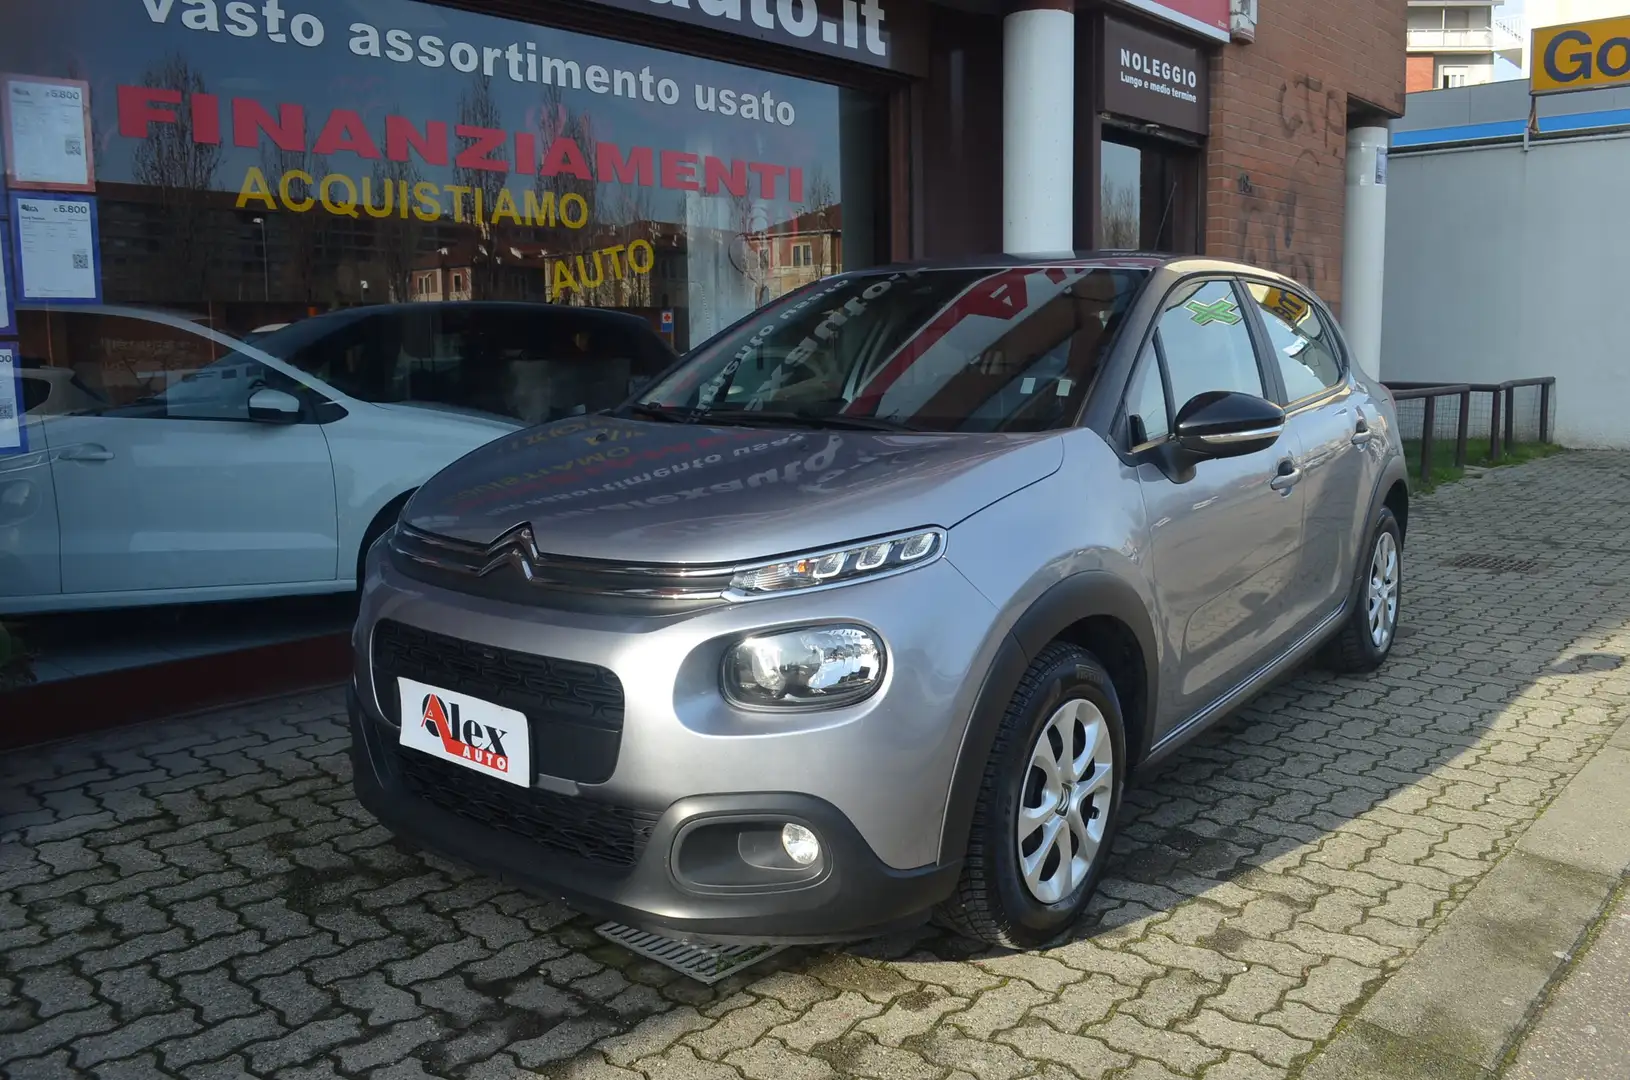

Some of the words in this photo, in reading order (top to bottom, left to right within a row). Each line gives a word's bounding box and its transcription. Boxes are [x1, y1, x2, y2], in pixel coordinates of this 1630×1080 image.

[140, 0, 326, 47] vasto
[348, 22, 680, 106] assortimento
[694, 83, 796, 127] usato
[1120, 48, 1197, 88] NOLEGGIO
[1543, 29, 1630, 83] Go
[1120, 71, 1142, 88] Lungo
[1143, 80, 1149, 89] e
[1149, 81, 1171, 96] medio
[1171, 87, 1197, 104] termine
[117, 84, 804, 203] FINANZIAMENTI
[236, 166, 589, 230] ACQUISTIAMO
[550, 238, 655, 300] AUTO
[420, 693, 508, 758] Alex
[462, 745, 506, 771] AUTO
